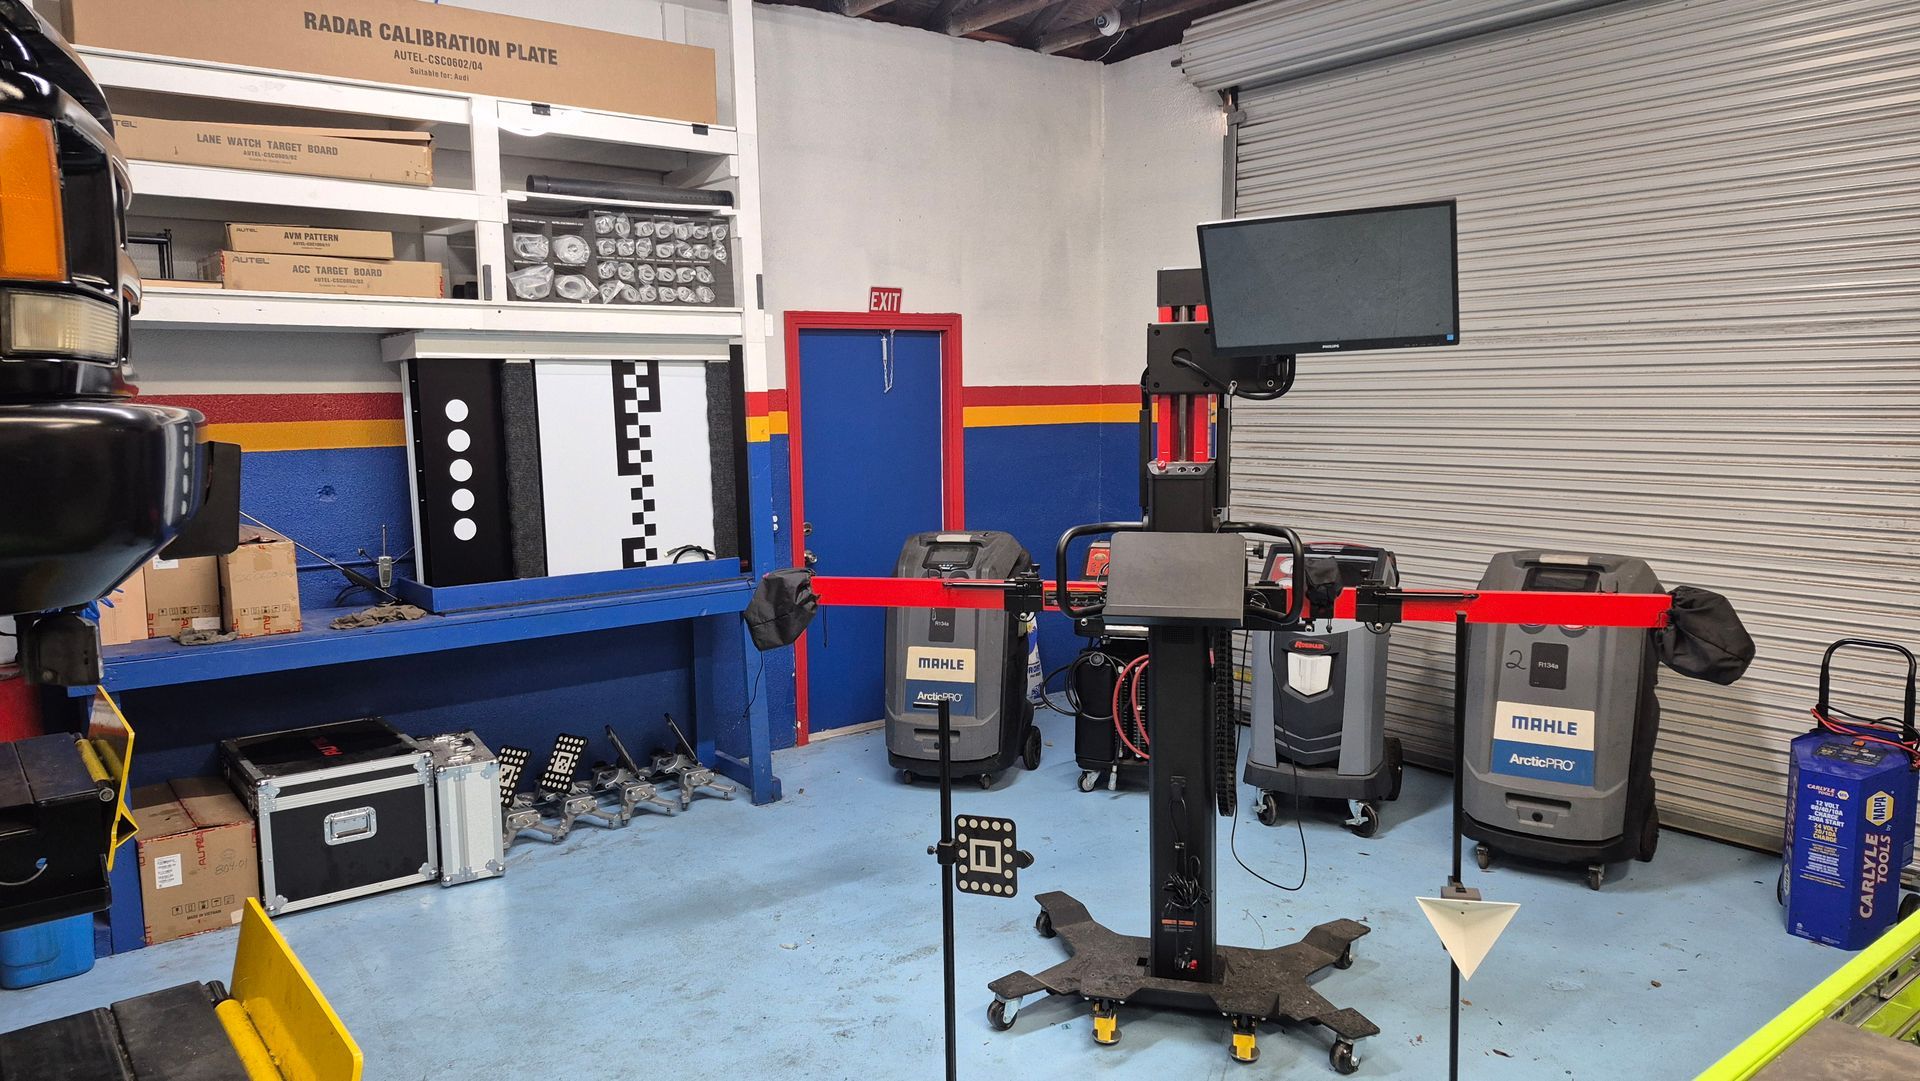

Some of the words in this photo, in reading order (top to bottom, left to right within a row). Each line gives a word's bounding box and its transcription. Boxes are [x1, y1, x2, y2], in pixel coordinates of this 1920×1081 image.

[304, 11, 373, 38] RADAR
[379, 22, 500, 57] CALIBRATION
[506, 42, 558, 65] PLATE
[393, 49, 483, 71] AUTEL-CSC0602/04
[409, 66, 439, 78] Suitable
[453, 73, 470, 82] Audi
[113, 119, 138, 129] TEL
[197, 133, 221, 144] LANE
[227, 136, 262, 149] WATCH
[267, 140, 302, 152] TARGET
[307, 144, 338, 156] BOARD
[283, 231, 303, 240] AVM
[304, 232, 339, 242] PATTERN
[232, 256, 270, 264] AUTEL
[292, 264, 311, 274] ACC
[316, 266, 349, 276] TARGET
[353, 267, 383, 277] BOARD
[870, 291, 900, 311] EXIT
[918, 657, 964, 671] MAHLE
[1505, 649, 1527, 670] 2
[1538, 661, 1559, 670] R134a
[1511, 715, 1578, 736] MAHLE
[1807, 783, 1835, 793] CARLYLE
[1824, 801, 1840, 810] VOLT
[1873, 796, 1887, 820] NAPA
[1814, 811, 1839, 821] CHARGE
[1825, 817, 1845, 828] START
[1822, 824, 1838, 833] VOLT
[1813, 833, 1837, 843] CHARGE
[1877, 835, 1891, 883] TOOLS
[1860, 833, 1878, 919] CARLYLE
